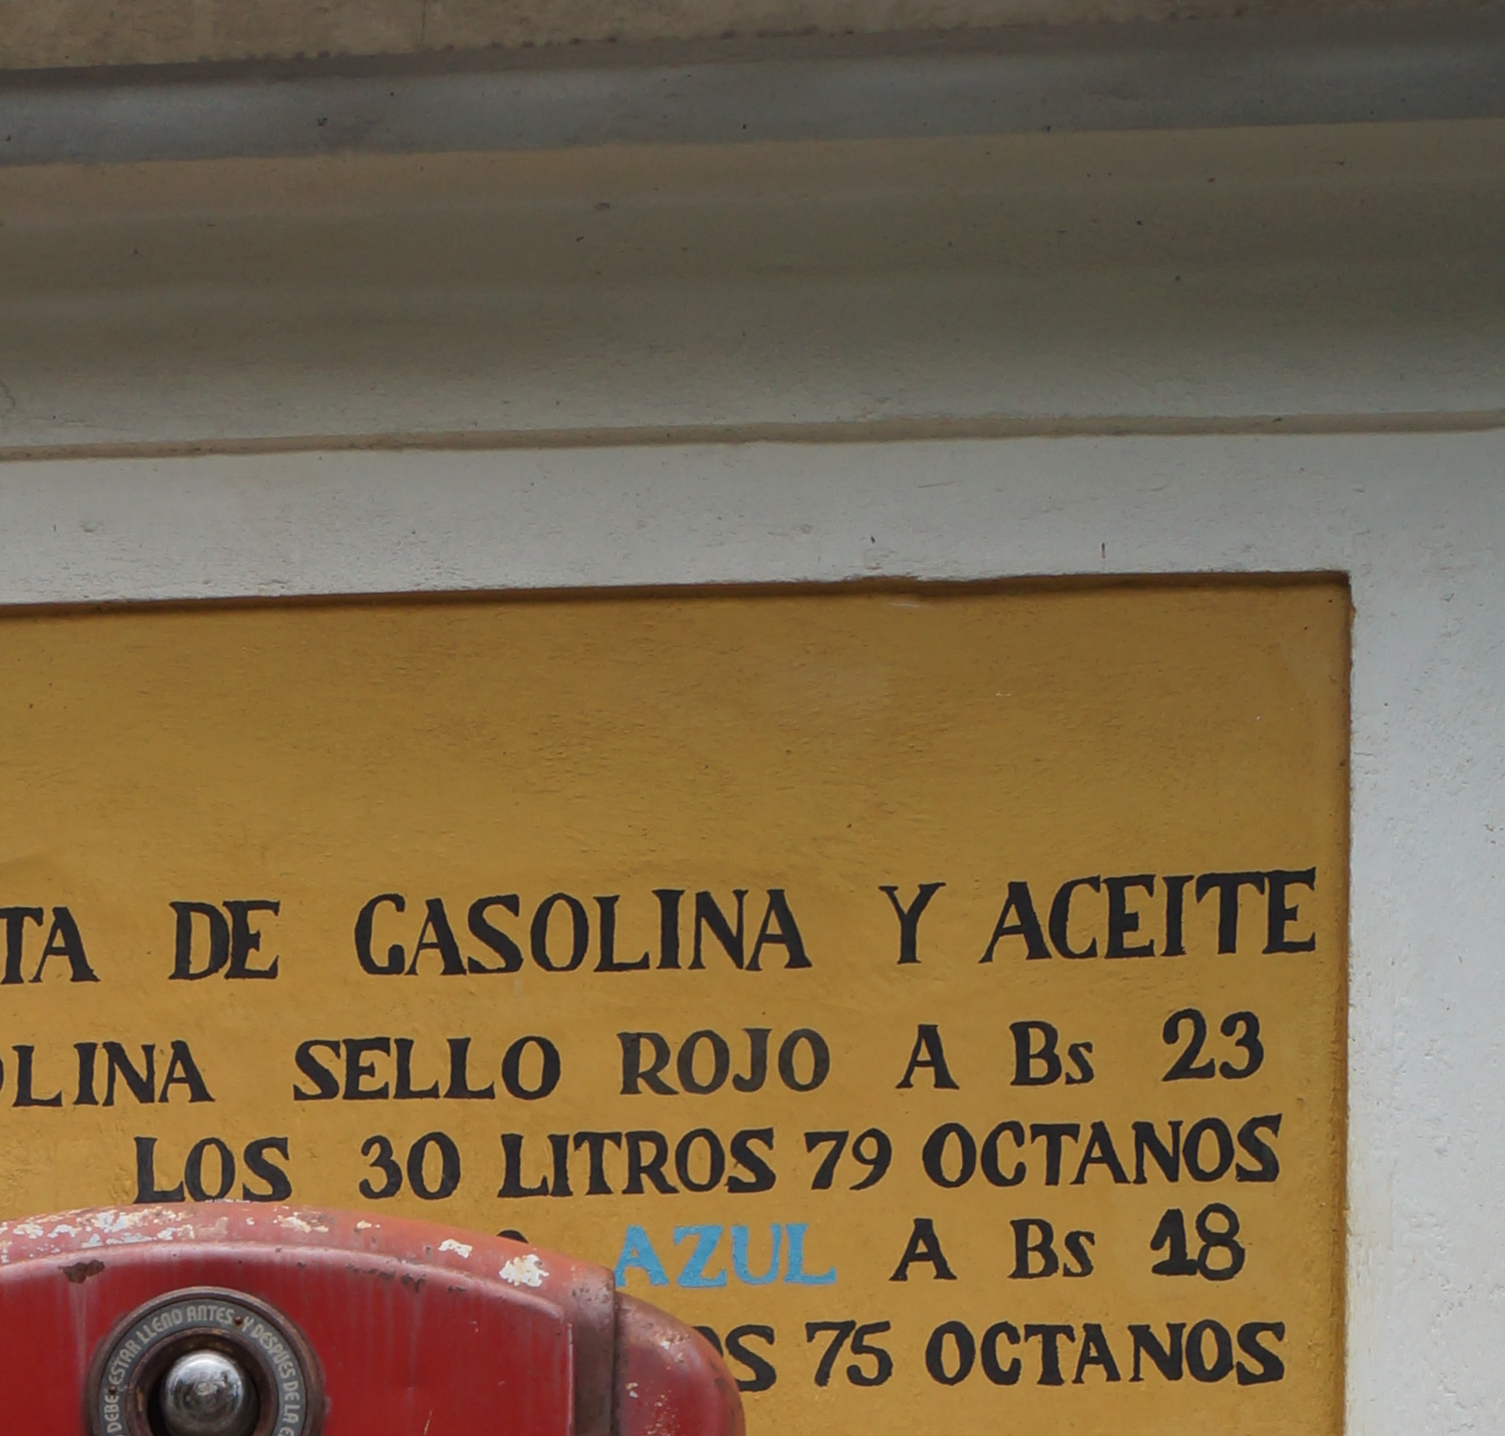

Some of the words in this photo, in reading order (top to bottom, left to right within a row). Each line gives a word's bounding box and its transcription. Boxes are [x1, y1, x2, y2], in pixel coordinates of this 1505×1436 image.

[169, 900, 280, 980] DE
[355, 889, 812, 975] GASOLINA
[879, 883, 946, 964] Y
[979, 867, 1316, 963] ACEITE
[294, 1036, 560, 1100] SELLO
[618, 1028, 829, 1094] ROJO
[897, 1024, 959, 1089] A
[1010, 1021, 1094, 1085] Bs
[1163, 1008, 1264, 1081] 23
[134, 1137, 291, 1203] LOS
[360, 1132, 460, 1199] 30
[498, 1128, 775, 1197] LITROS
[805, 1128, 891, 1190] 79
[923, 1114, 1282, 1188] OCTANOS
[614, 1222, 837, 1288] AZUL
[890, 1218, 956, 1281] A
[1009, 1219, 1094, 1278] Bs
[1151, 1203, 1245, 1280] 18
[136, 1308, 183, 1344] LLENO
[187, 1305, 234, 1325] ANTES
[109, 1339, 141, 1386] ESTAR
[250, 1323, 296, 1380] DESPUES
[806, 1320, 892, 1386] 75
[926, 1320, 1285, 1385] OCTANOS
[104, 1394, 122, 1434] DEBE
[283, 1380, 300, 1401] DE
[284, 1404, 300, 1424] LA
